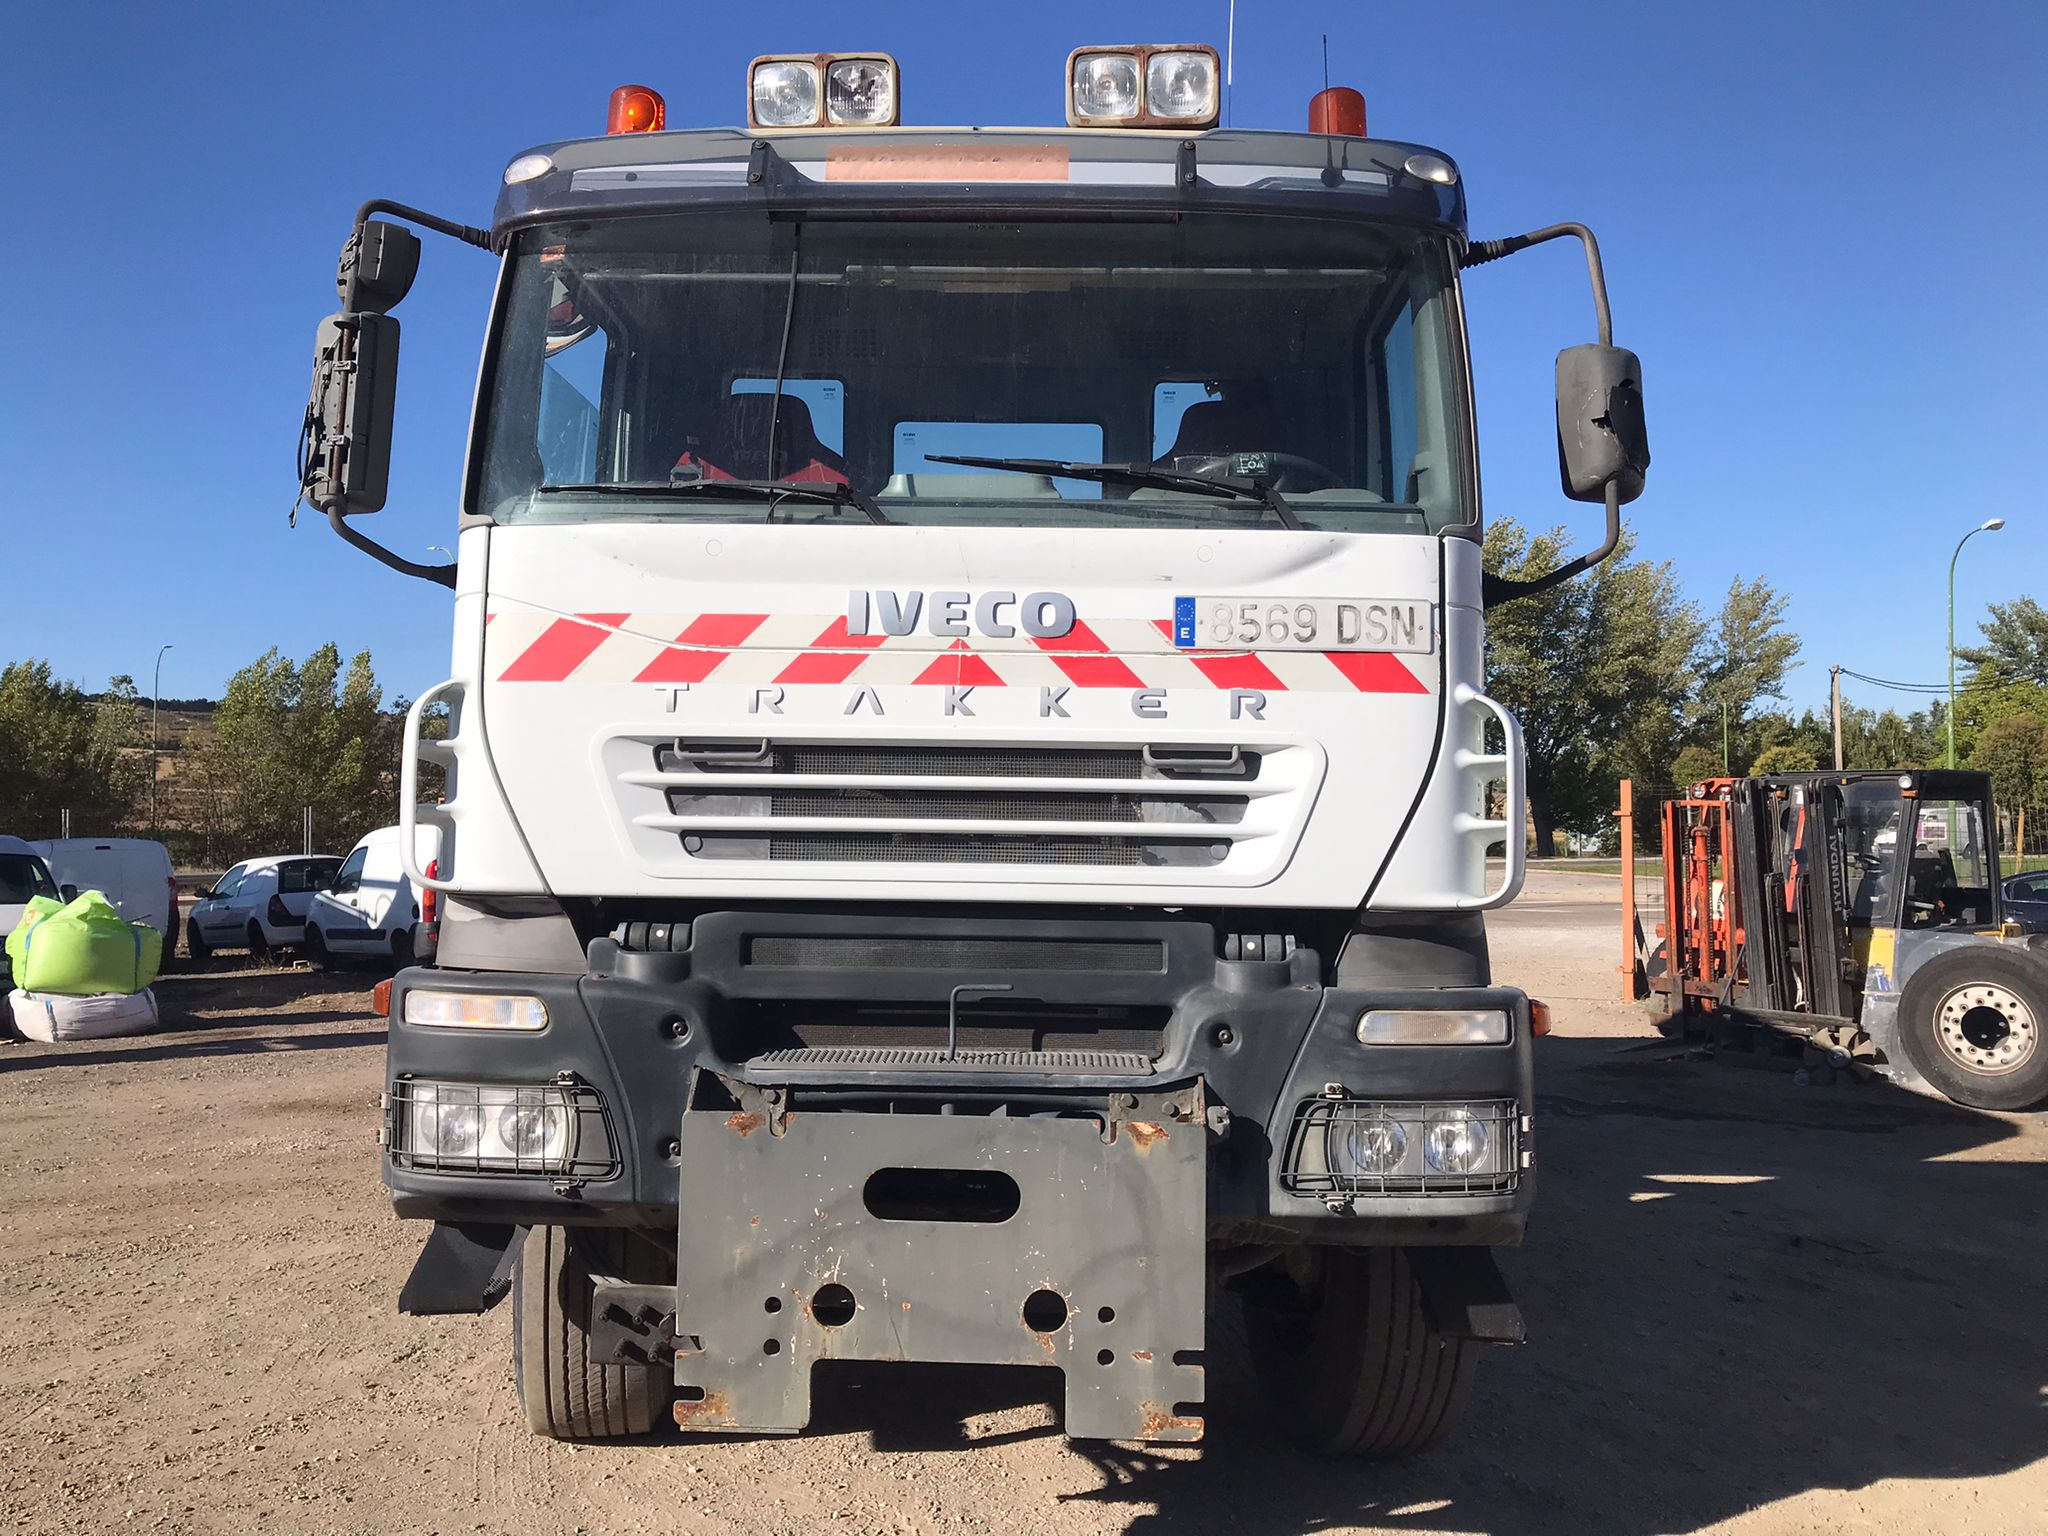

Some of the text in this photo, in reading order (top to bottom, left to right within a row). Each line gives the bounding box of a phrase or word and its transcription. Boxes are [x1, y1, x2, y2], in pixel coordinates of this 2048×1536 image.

[848, 590, 1076, 638] IVECO
[1180, 627, 1190, 638] E
[1211, 603, 1415, 645] 8569 DSN
[654, 682, 1267, 721] TRAKKER
[1829, 834, 1842, 912] HYUNDAI
